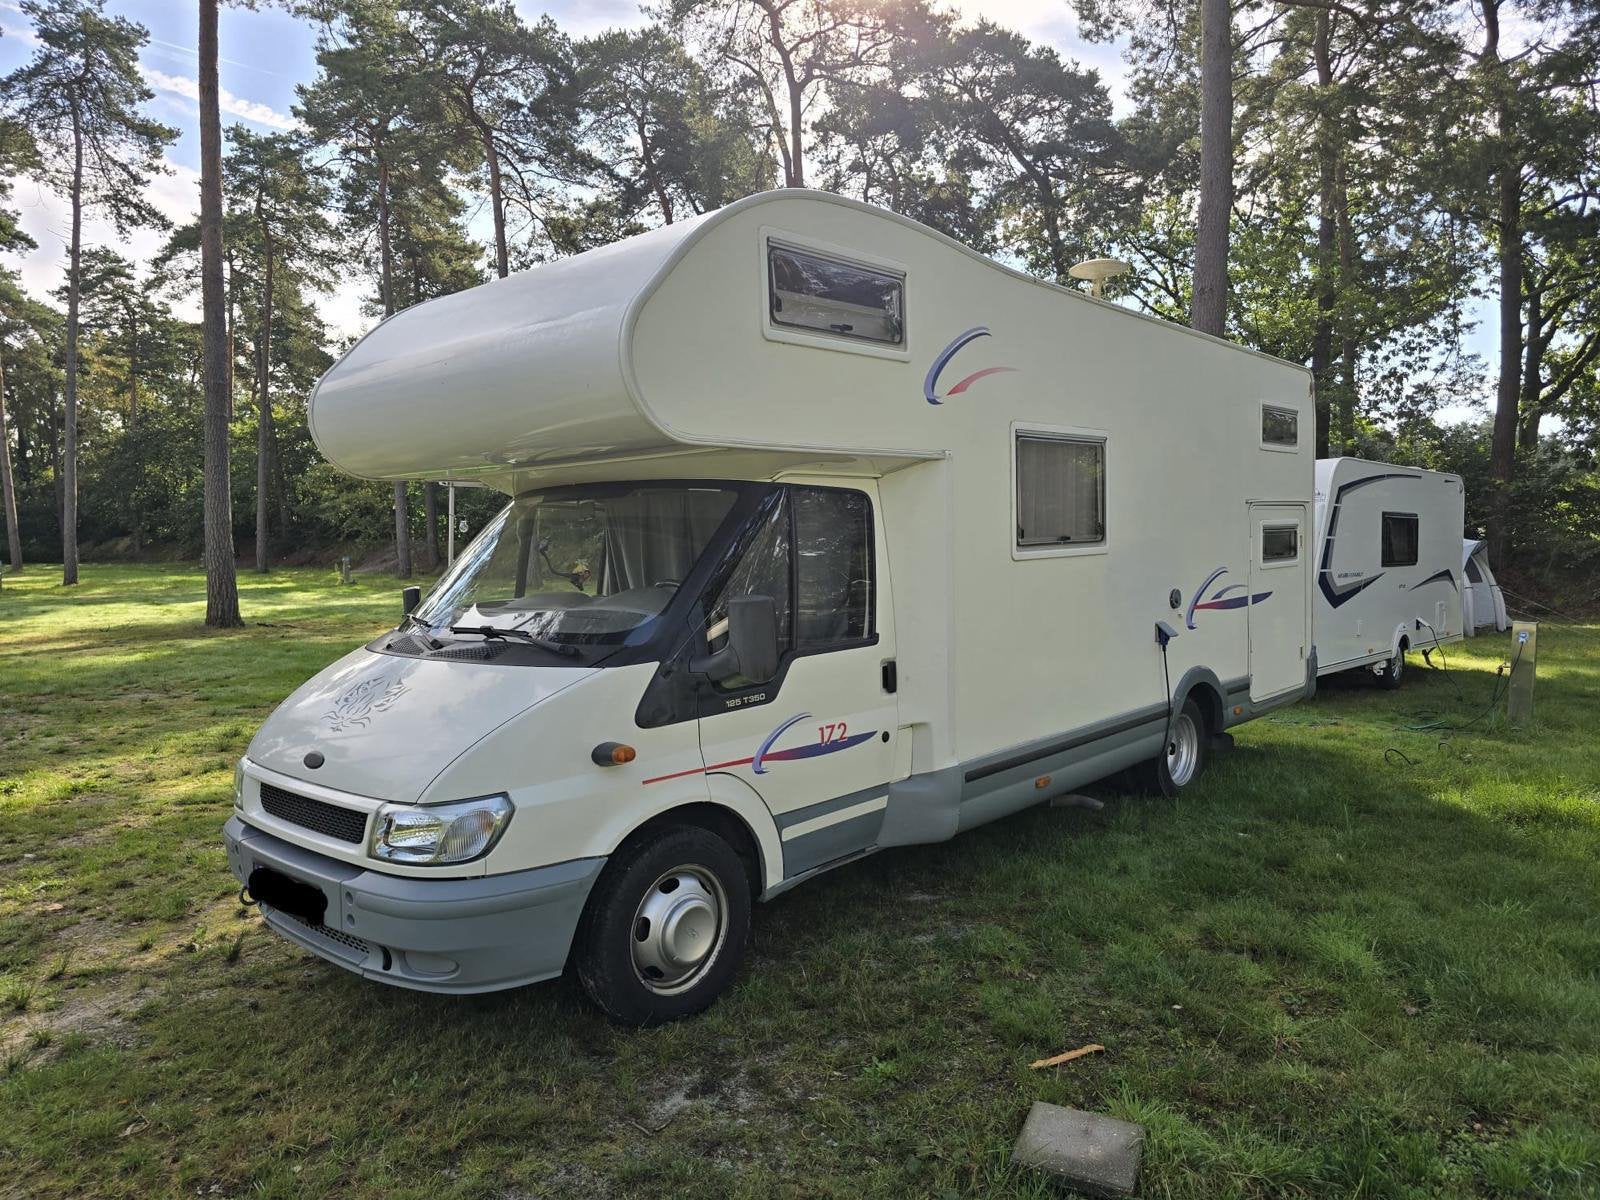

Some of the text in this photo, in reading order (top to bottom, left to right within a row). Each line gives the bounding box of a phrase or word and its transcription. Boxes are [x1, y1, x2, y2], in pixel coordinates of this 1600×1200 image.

[726, 693, 766, 708] 125 T350
[818, 722, 848, 745] 172
